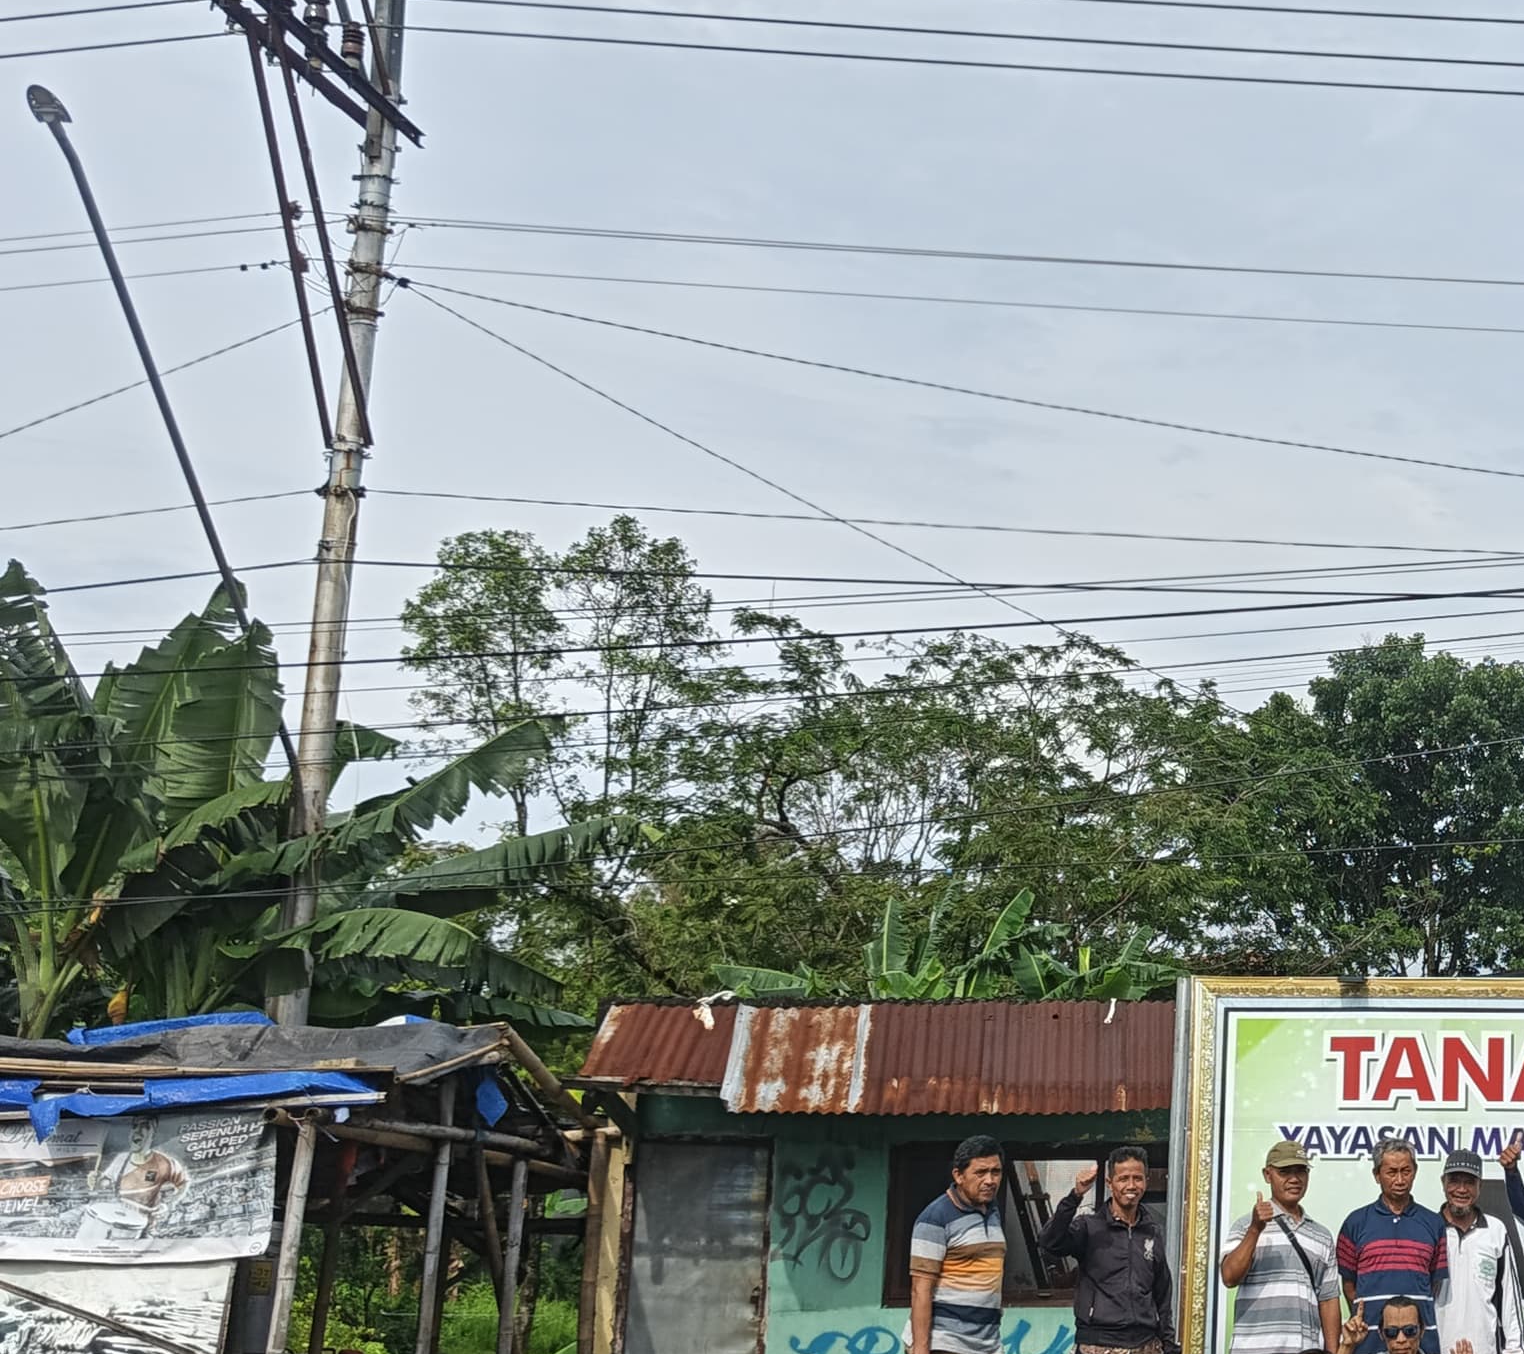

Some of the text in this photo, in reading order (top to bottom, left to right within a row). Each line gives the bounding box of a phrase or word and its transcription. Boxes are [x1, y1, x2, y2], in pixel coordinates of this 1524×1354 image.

[179, 1116, 241, 1133] PASSION
[180, 1124, 248, 1143] SEPENUH
[187, 1138, 218, 1152] GAK
[192, 1145, 242, 1160] SITUA
[0, 1179, 47, 1195] CHOOSE
[4, 1196, 39, 1214] LIVE!
